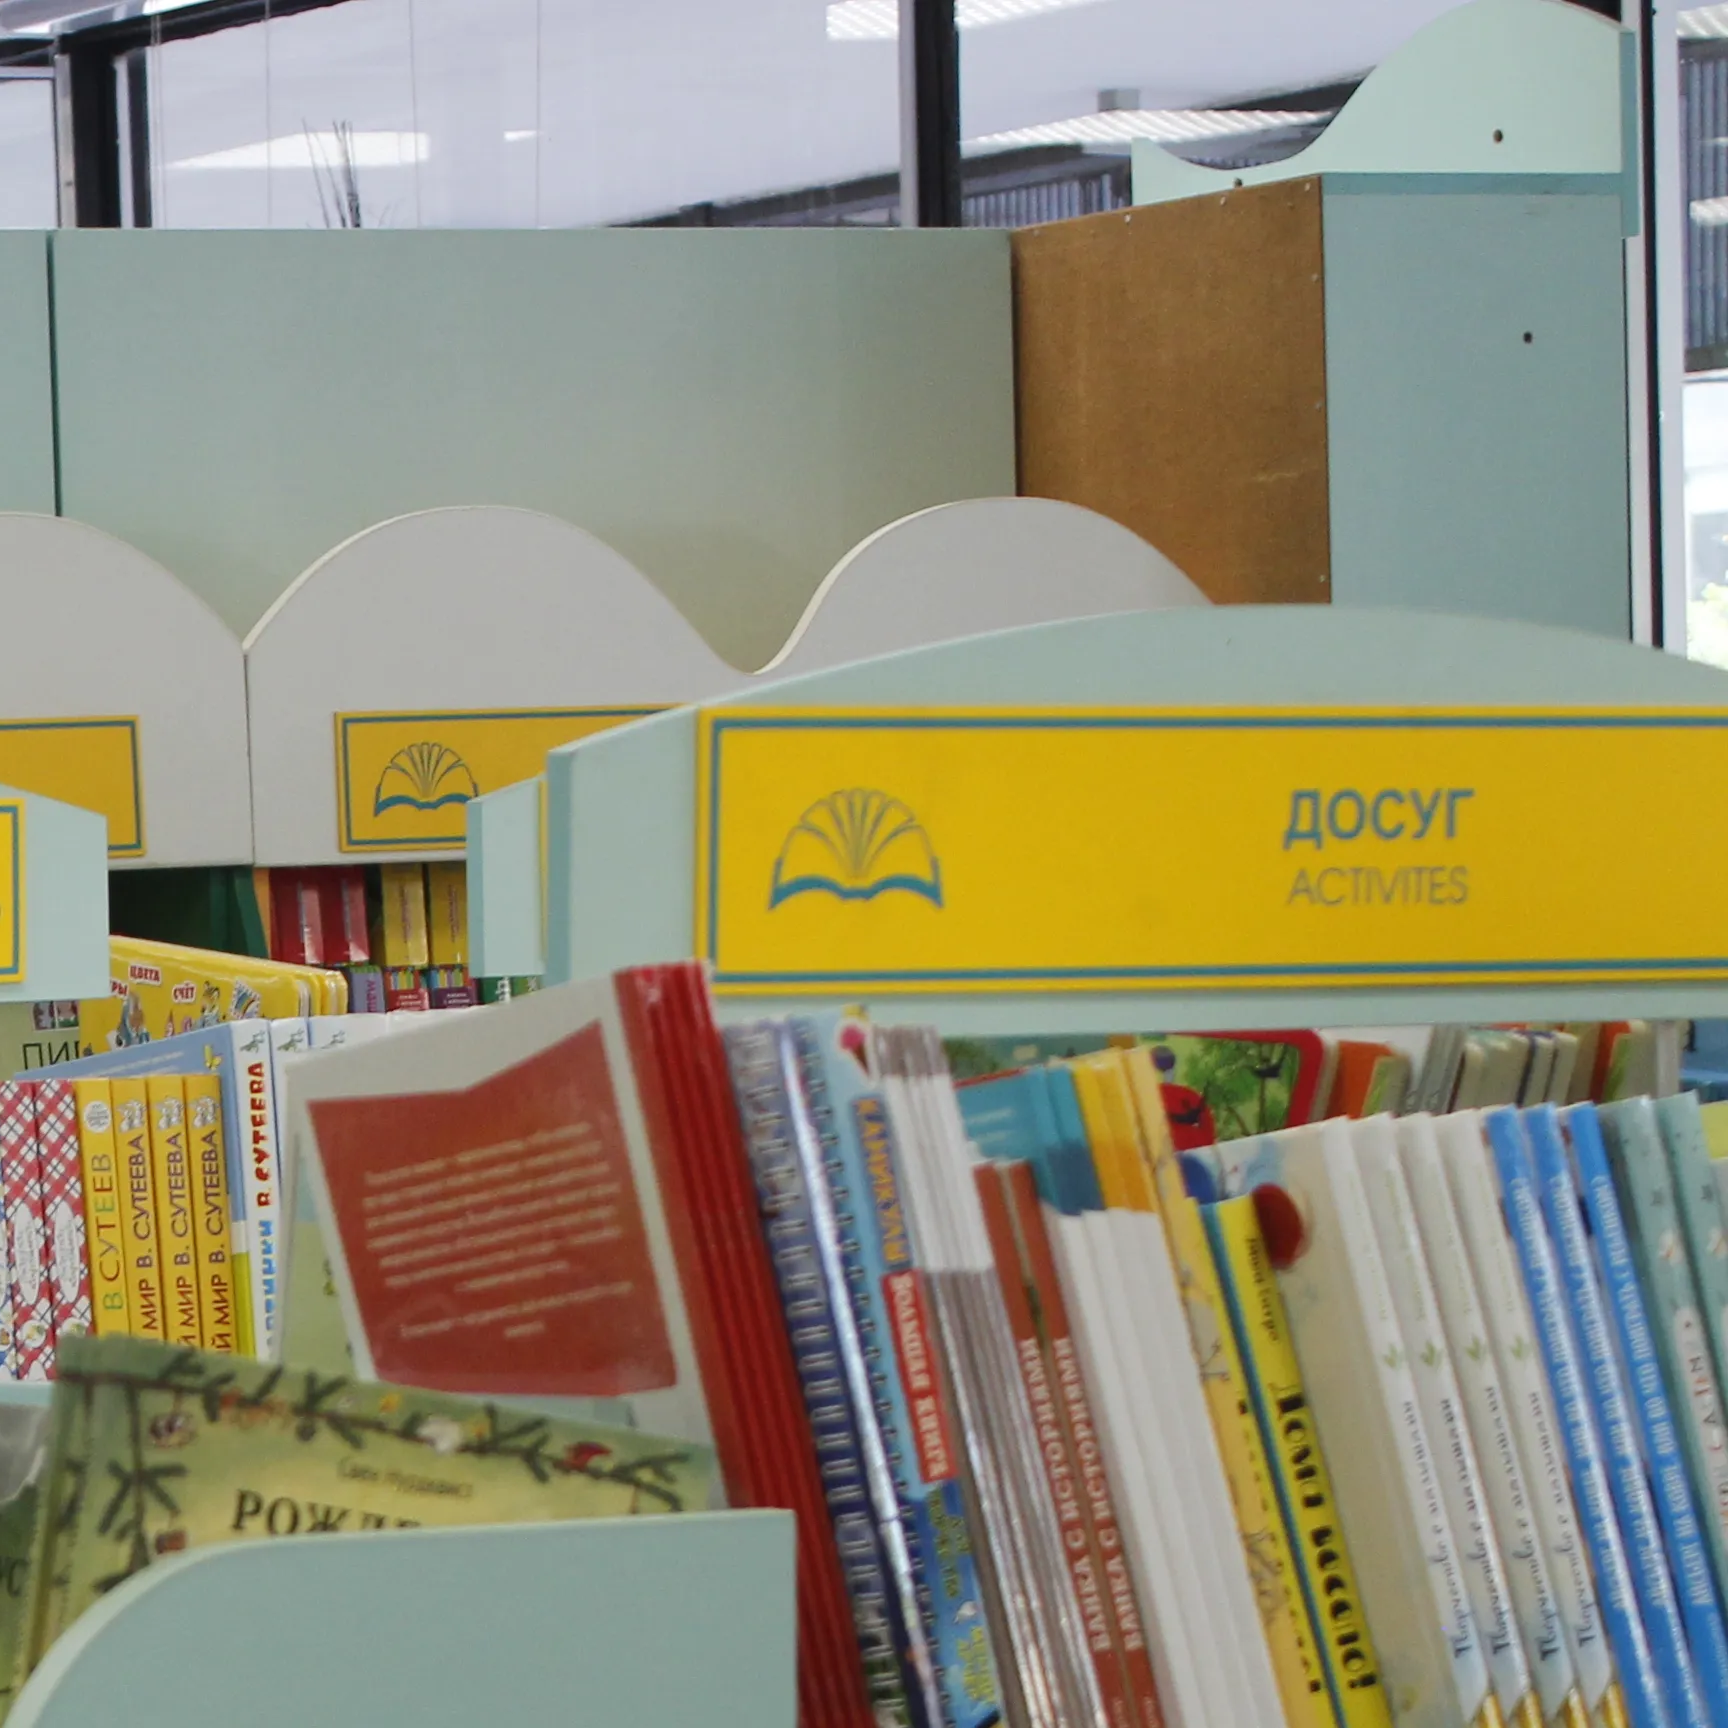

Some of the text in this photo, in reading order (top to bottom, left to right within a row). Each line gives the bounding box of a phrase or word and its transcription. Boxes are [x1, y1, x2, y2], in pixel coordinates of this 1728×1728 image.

[1283, 788, 1475, 851] ДОСУГ
[1285, 864, 1470, 907] ACTIVITES
[130, 964, 161, 985] ЦВЕТА
[200, 1129, 224, 1236] СУТЕЕВА
[247, 1062, 273, 1182] СУТЕЕВА
[851, 1094, 913, 1267] КАНИКУЛЫ
[90, 1153, 124, 1312] В СУТЕЕВ
[127, 1133, 159, 1331] МИР В. СУТЕЕВА
[165, 1131, 197, 1328] МИР В. СУТЕЕВА
[208, 1243, 226, 1265] В.
[210, 1273, 231, 1327] МИР
[888, 1271, 950, 1479] БОЛЬШАЯ КНИГА
[1016, 1334, 1113, 1653] БАНКА С ИСТОРИЯМИ
[1050, 1333, 1145, 1652] БАНКА С ИСТОРИЯМИ
